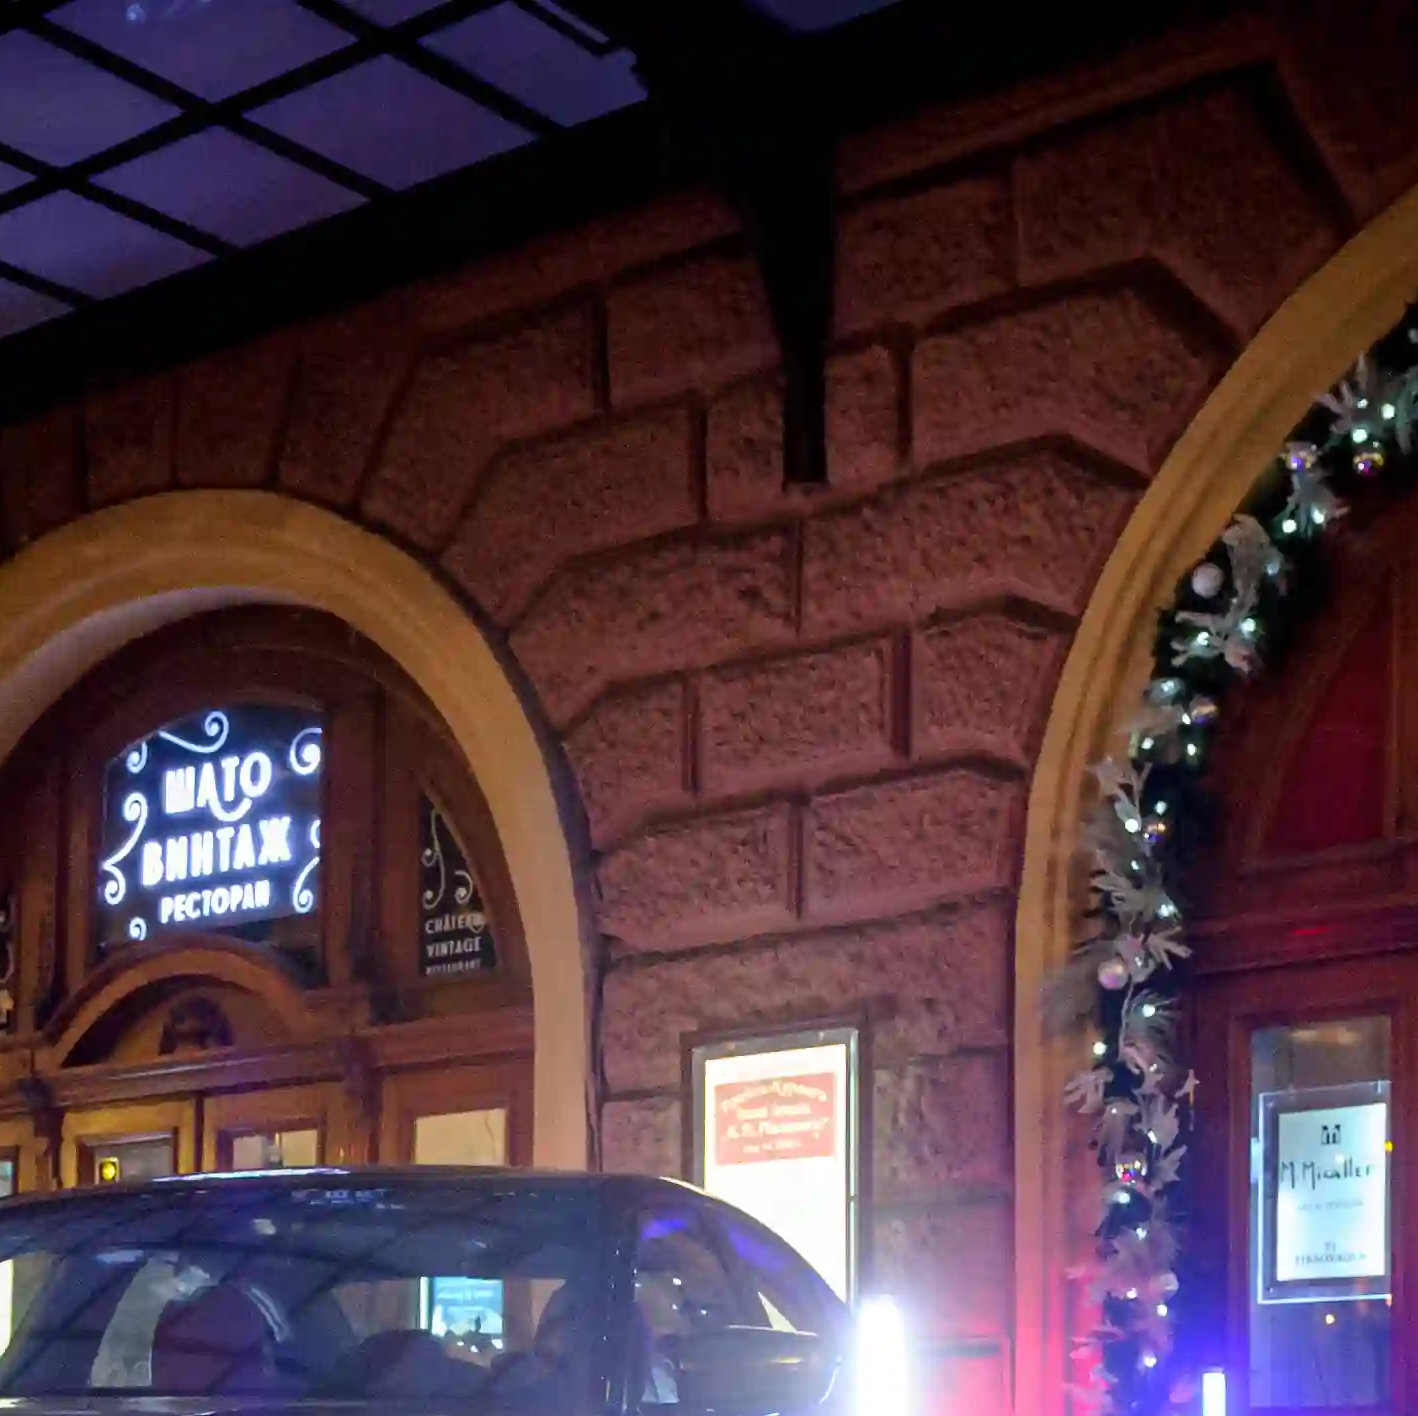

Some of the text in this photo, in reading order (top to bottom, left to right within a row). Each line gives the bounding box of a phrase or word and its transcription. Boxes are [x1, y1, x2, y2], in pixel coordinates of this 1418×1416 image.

[164, 751, 272, 818] ШАТО
[143, 817, 290, 886] ВИНТАЖ
[161, 880, 269, 923] РЕСТОРАН
[426, 938, 481, 957] VINTAGE
